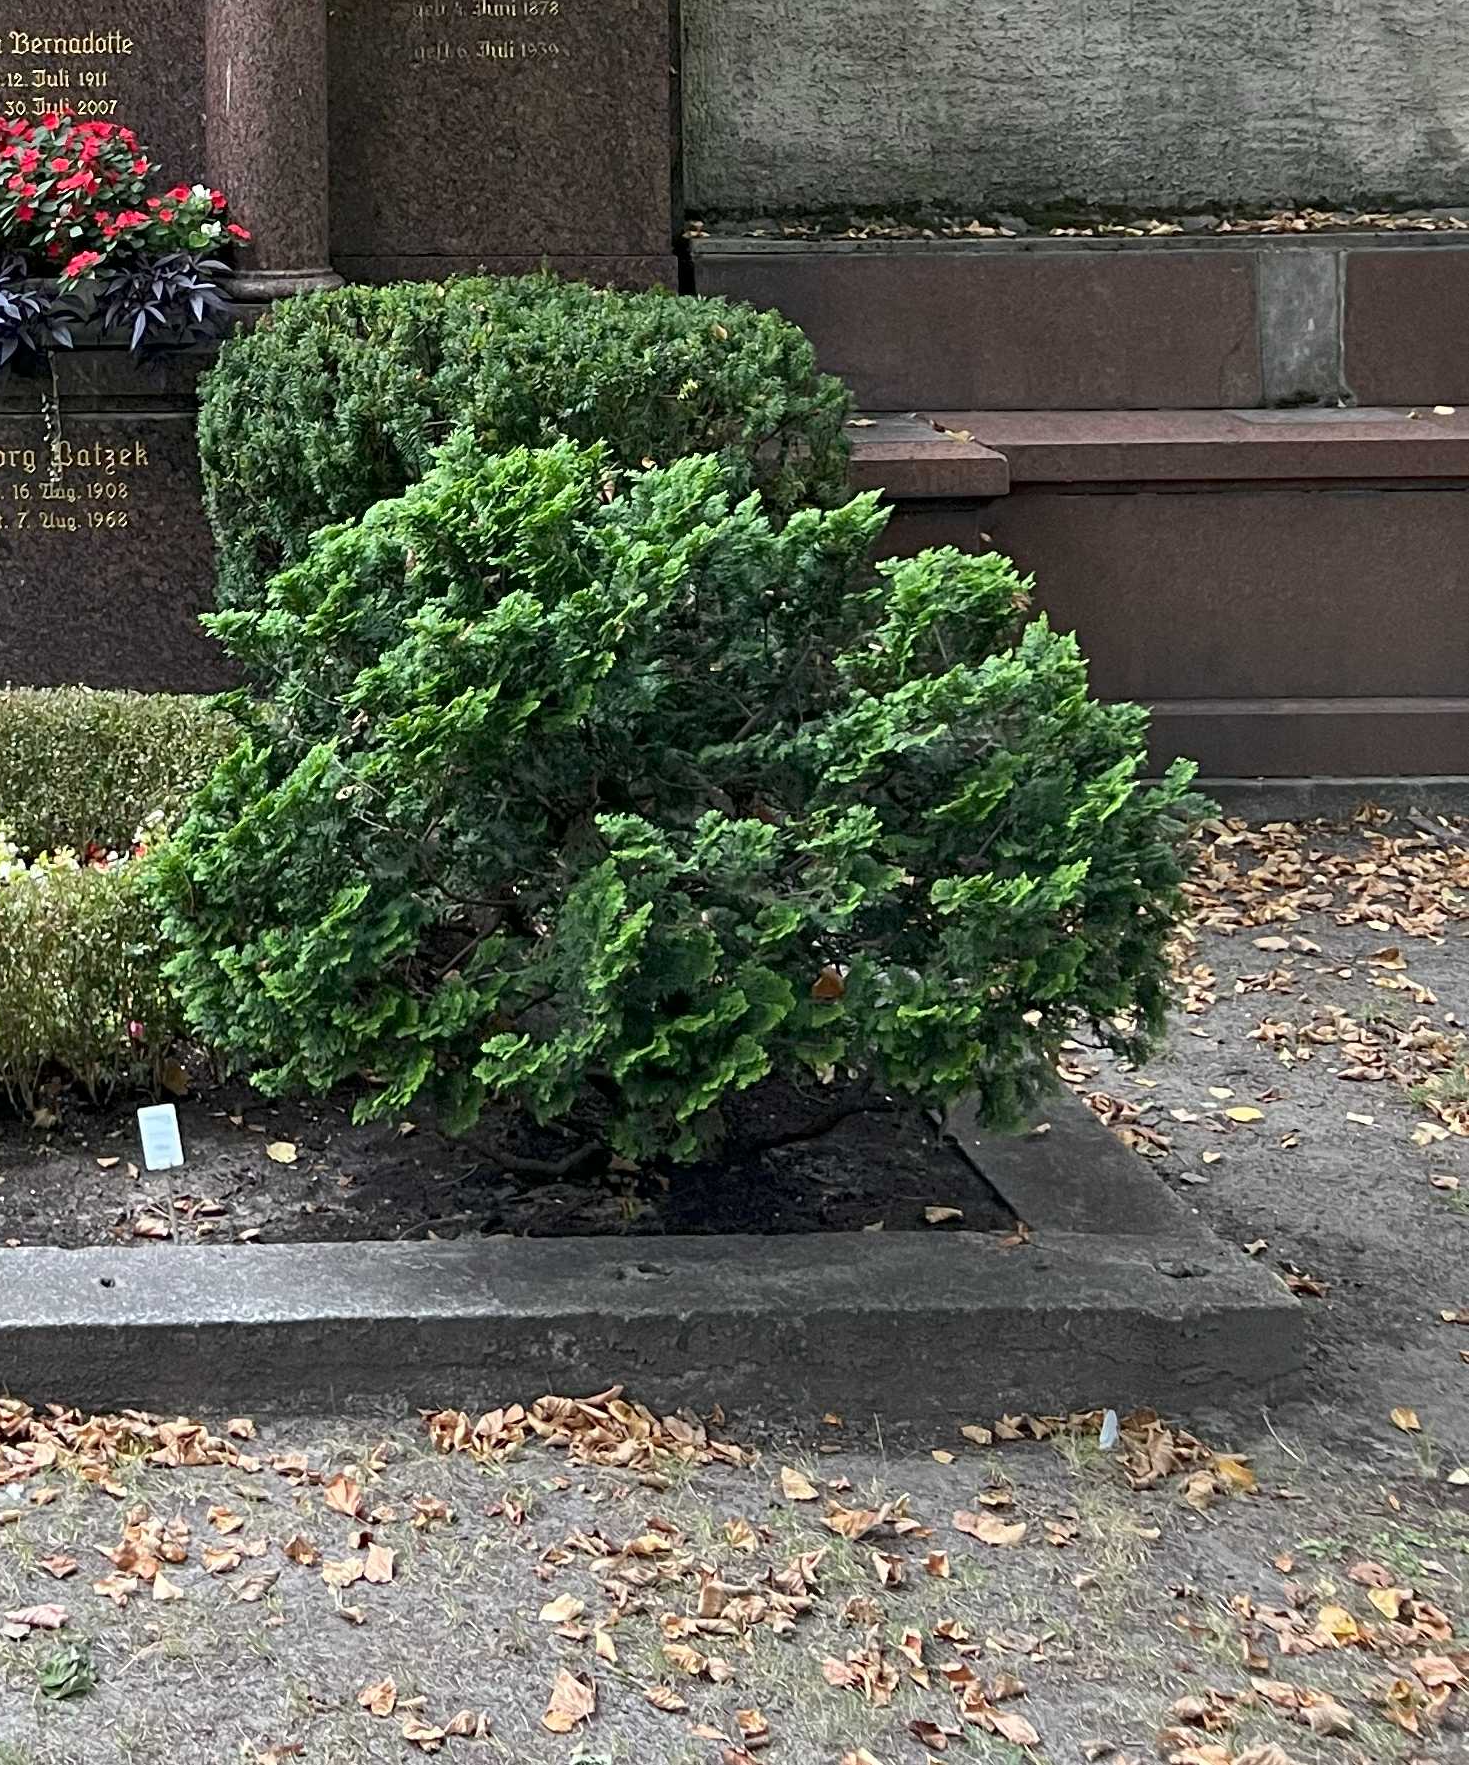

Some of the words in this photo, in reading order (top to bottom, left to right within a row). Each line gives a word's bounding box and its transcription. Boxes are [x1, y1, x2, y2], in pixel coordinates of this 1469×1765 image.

[523, 0, 559, 16] 1878
[9, 29, 134, 55] Bernadotte
[475, 40, 514, 59] Juli
[7, 72, 29, 87] 12.
[32, 68, 70, 88] Juli
[79, 71, 107, 87] 1911
[32, 97, 70, 116] Juli
[77, 99, 118, 116] 2007
[38, 482, 82, 503] Aug.
[86, 482, 129, 499] 1908
[17, 512, 31, 529] 7.
[39, 512, 82, 532] Aug.
[87, 510, 128, 529] 1968
